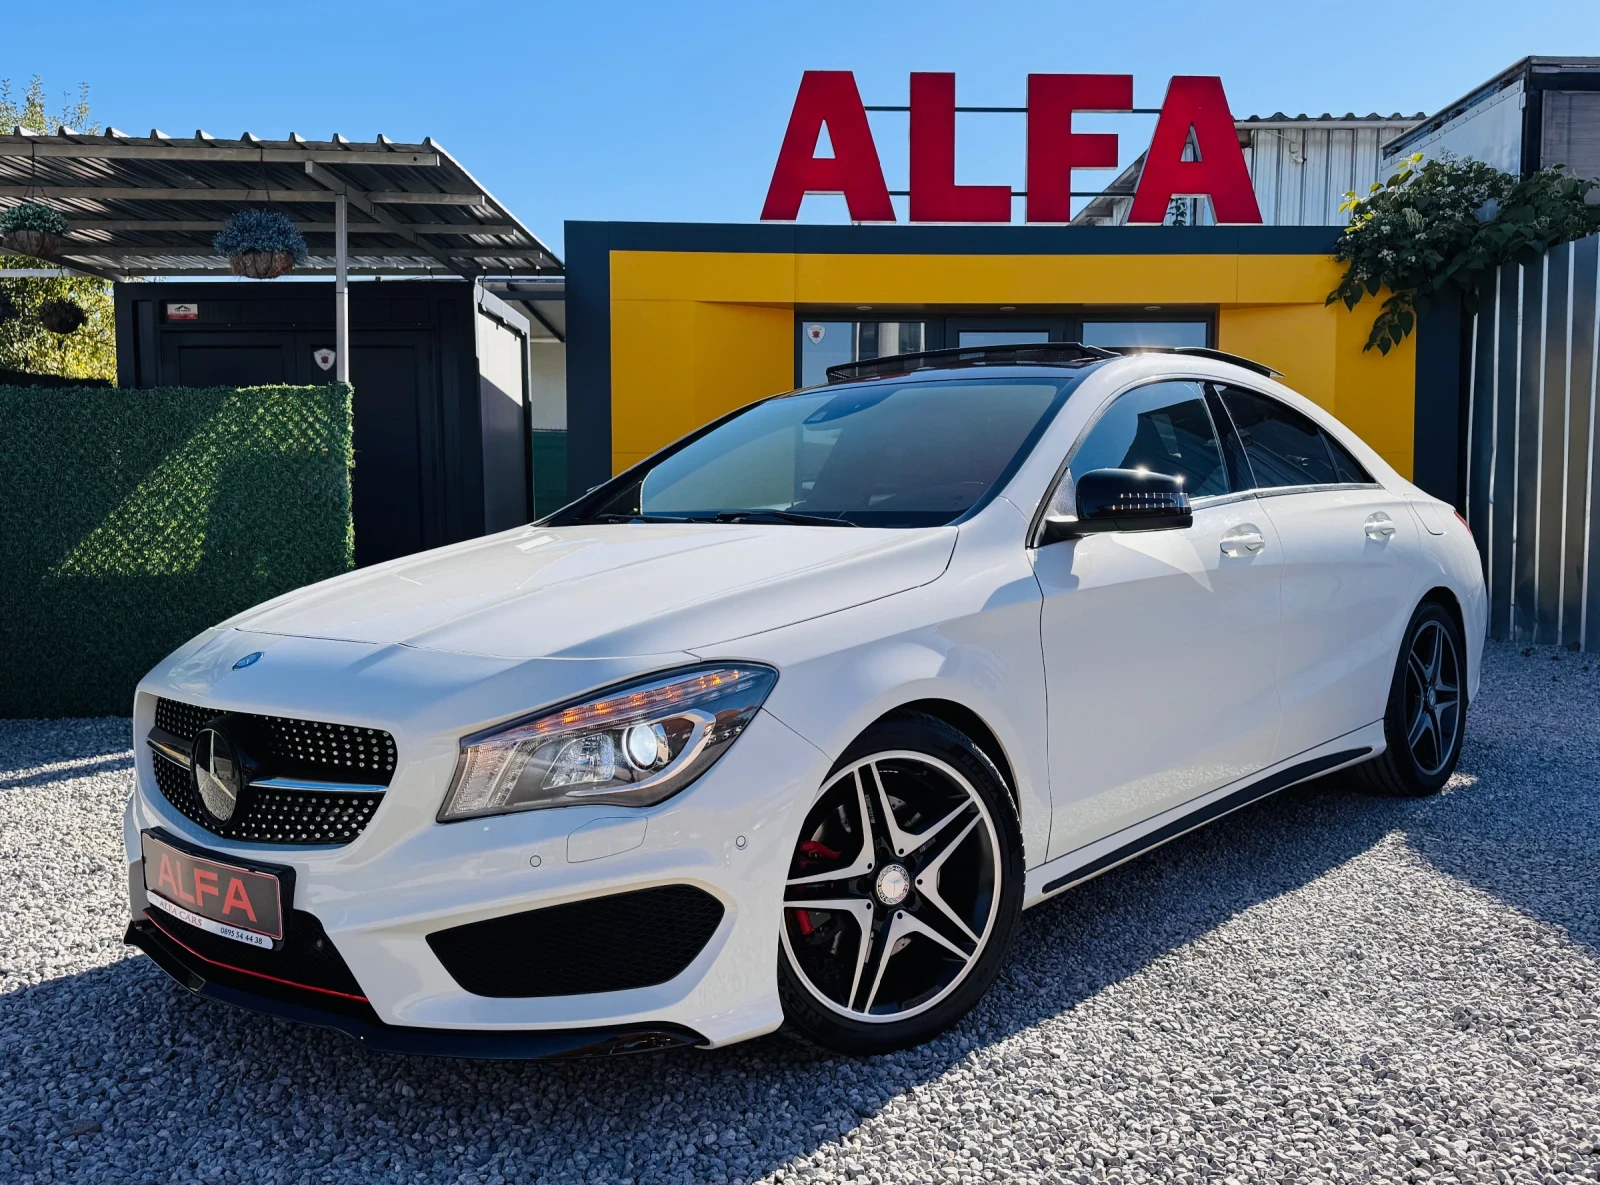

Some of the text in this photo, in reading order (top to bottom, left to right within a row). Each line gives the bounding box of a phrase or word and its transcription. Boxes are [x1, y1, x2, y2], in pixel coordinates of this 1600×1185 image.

[760, 70, 1264, 224] ALFA
[158, 853, 258, 923] ALFA
[160, 900, 263, 945] ALFA CARS 0895 54 44 38
